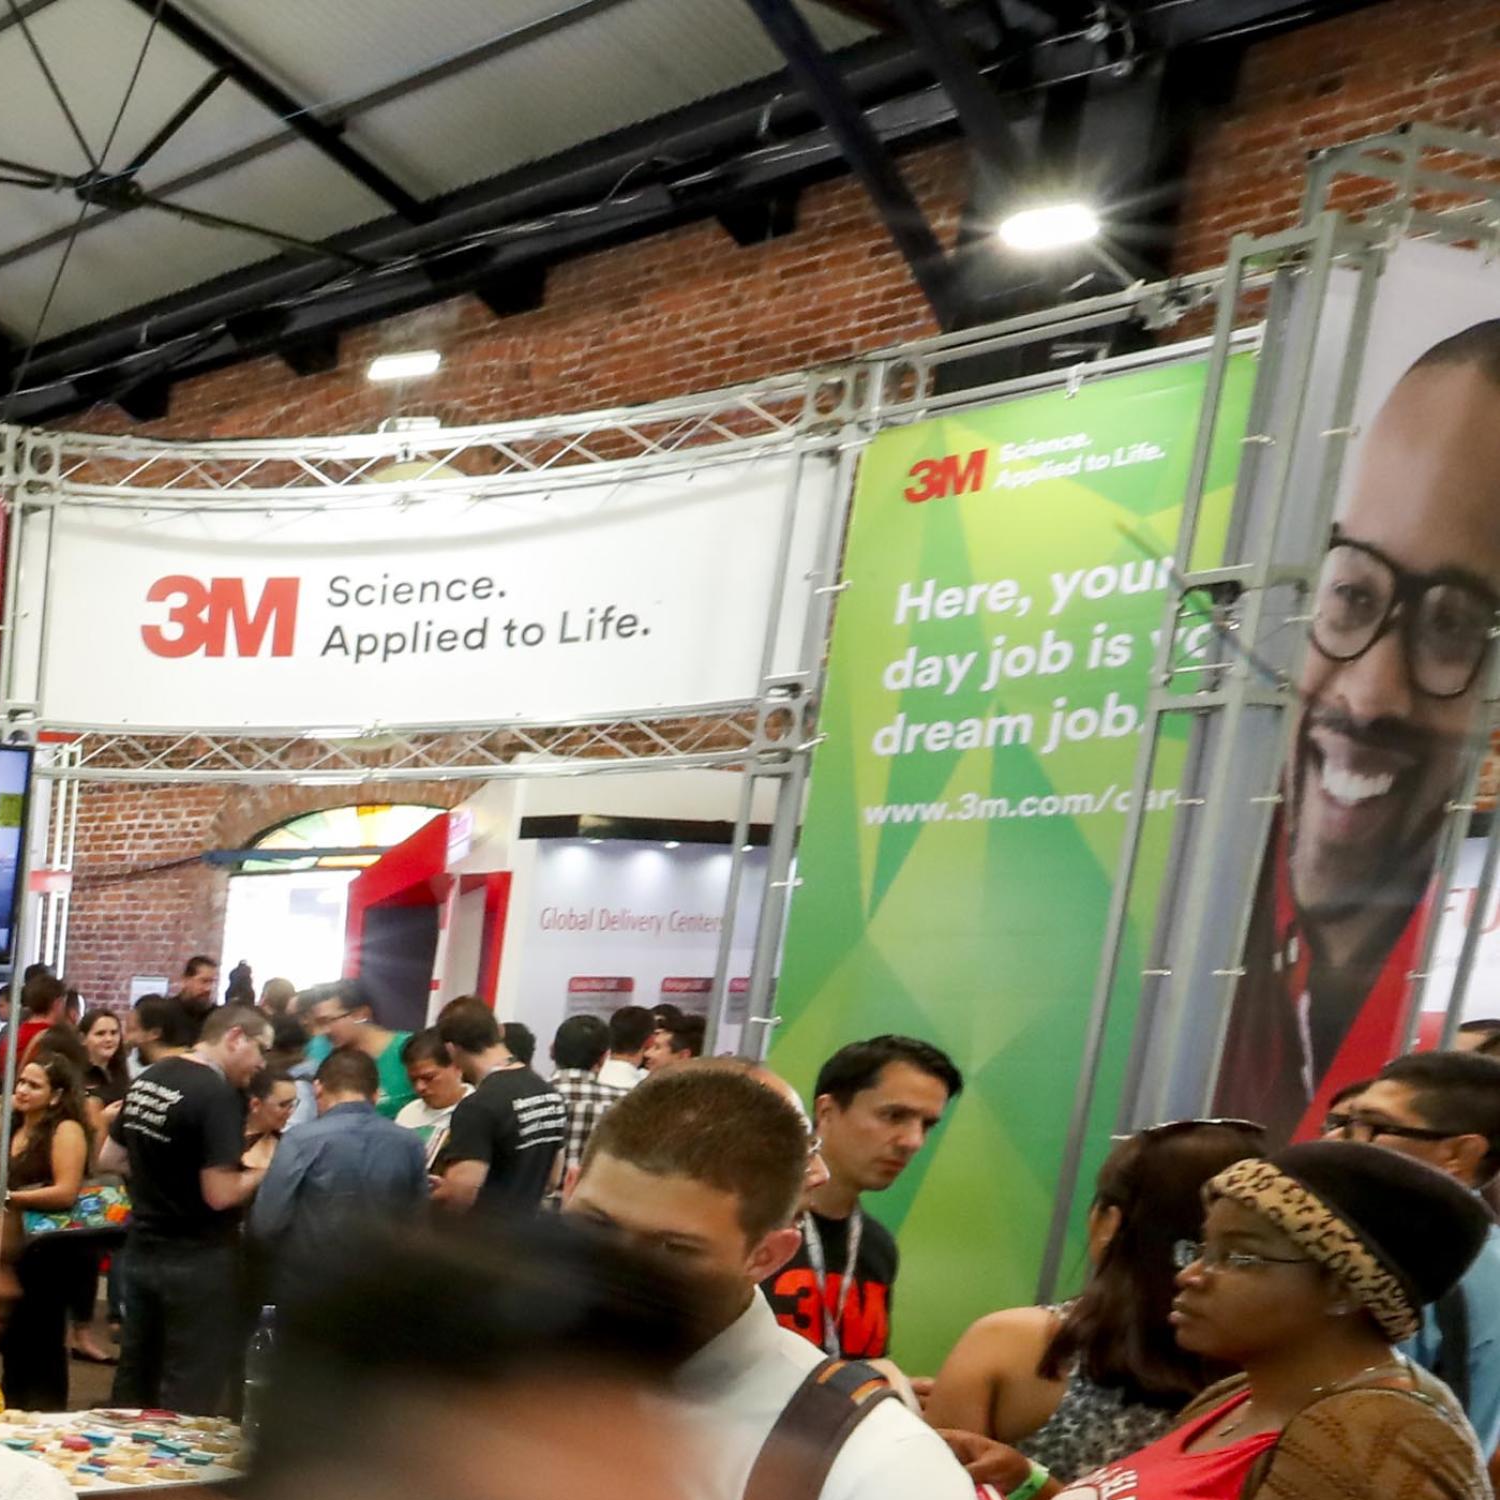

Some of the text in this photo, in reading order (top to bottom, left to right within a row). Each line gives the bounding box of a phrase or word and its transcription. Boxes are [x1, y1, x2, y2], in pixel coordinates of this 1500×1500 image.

[993, 441, 1166, 489] Applied to Life.
[998, 432, 1092, 463] Science.
[903, 448, 989, 504] 3M
[326, 574, 508, 608] Science.
[892, 576, 1032, 626] Here,
[140, 574, 301, 659] 3M
[320, 604, 652, 665] Applied to Life.
[882, 645, 979, 695] day
[980, 629, 1075, 692] job
[1086, 622, 1135, 670] is
[871, 712, 1034, 757] dream
[862, 784, 1182, 826] www.3m.com/car
[539, 906, 594, 931] Global
[598, 907, 666, 936] Delivery
[774, 1266, 889, 1358] 3M
